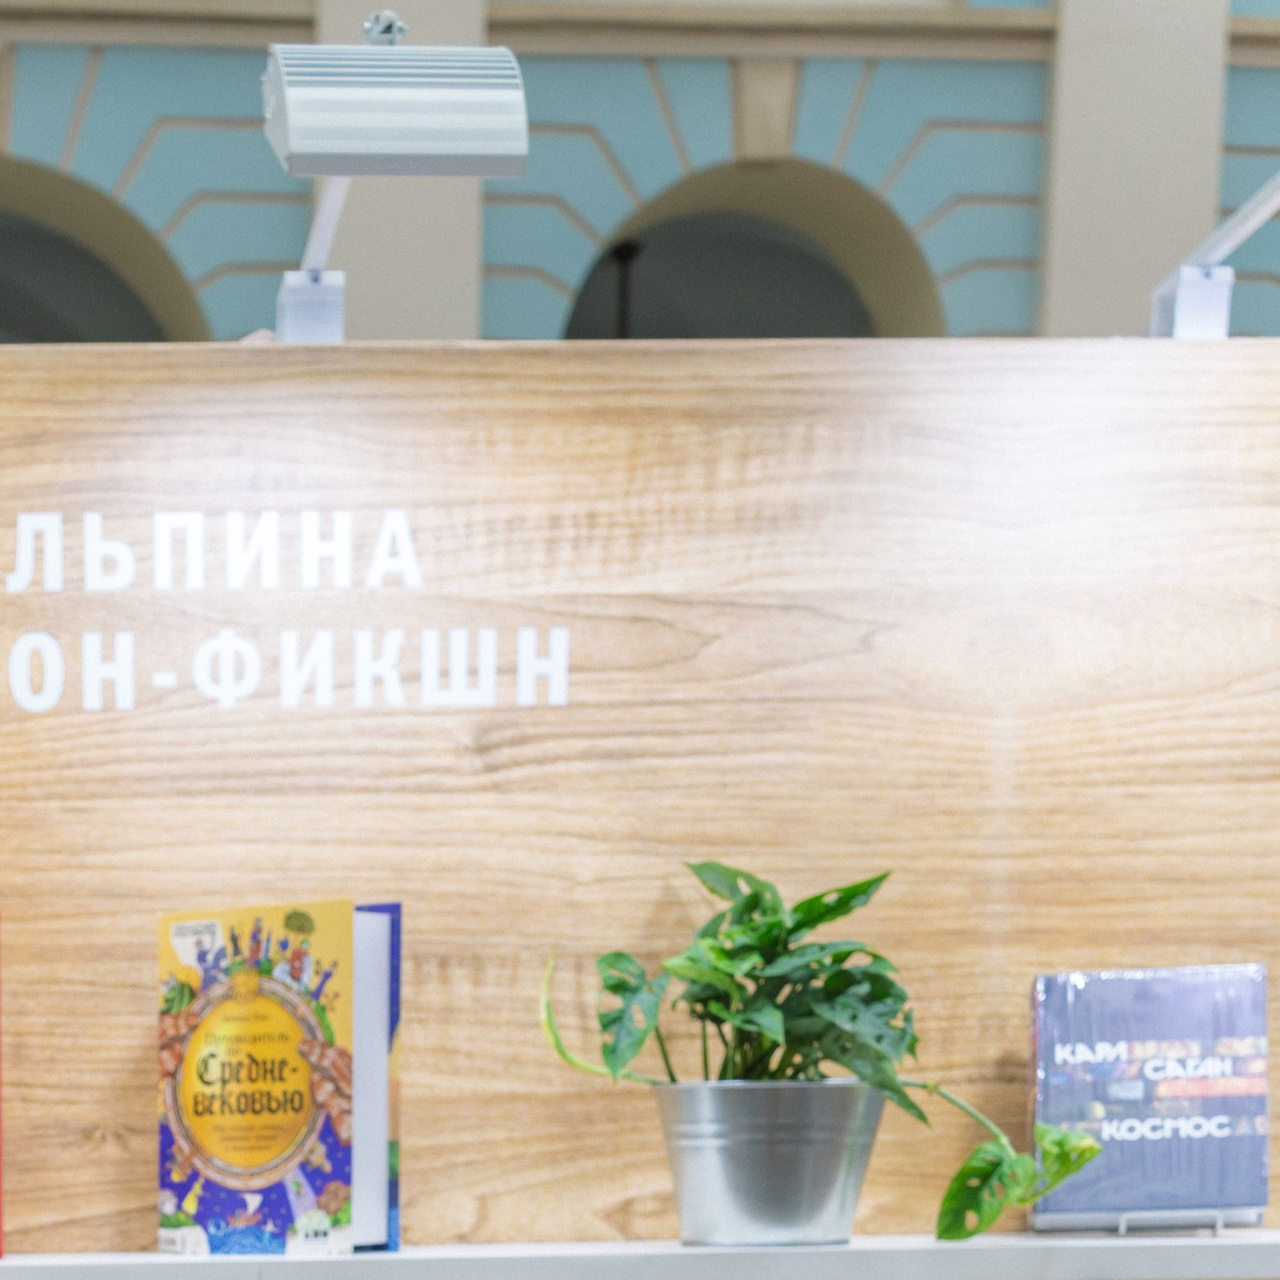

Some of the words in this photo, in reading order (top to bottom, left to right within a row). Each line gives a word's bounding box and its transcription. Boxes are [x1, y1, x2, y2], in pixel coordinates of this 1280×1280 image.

[197, 1053, 300, 1092] Средне-
[193, 1089, 305, 1117] вековью
[1101, 1115, 1232, 1141] КОСМОС
